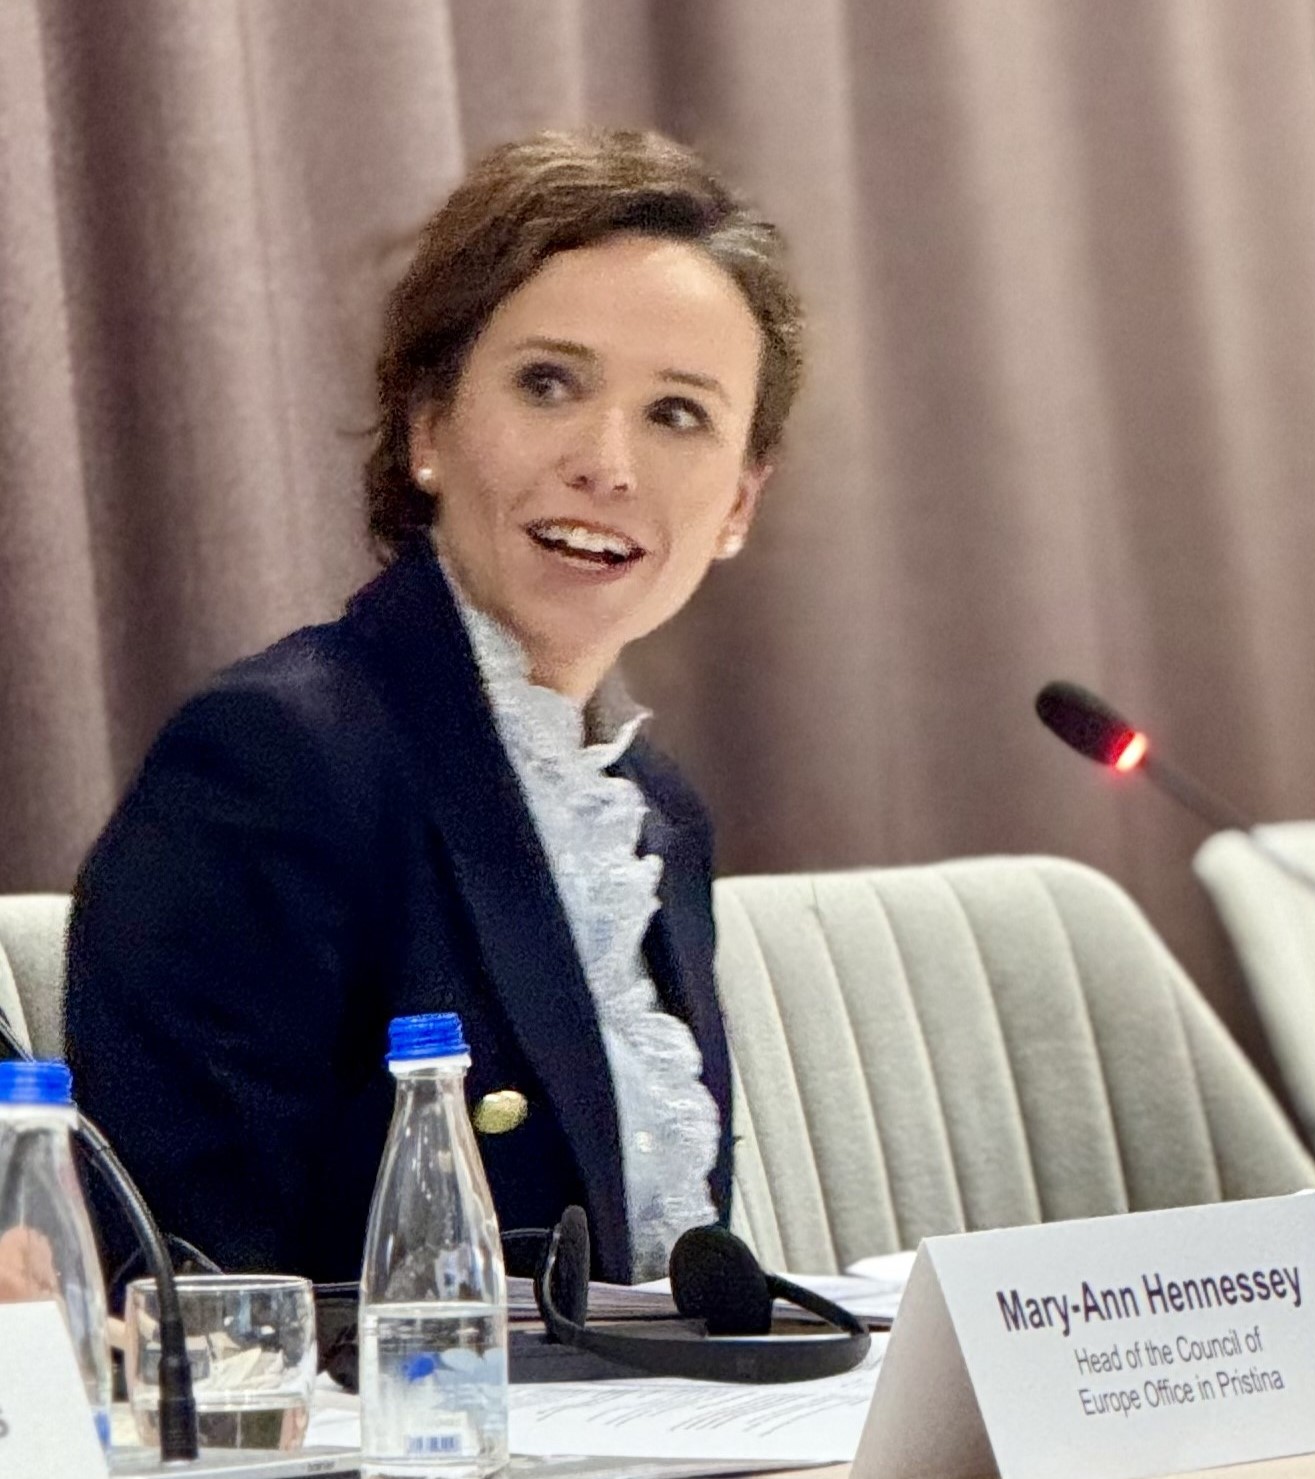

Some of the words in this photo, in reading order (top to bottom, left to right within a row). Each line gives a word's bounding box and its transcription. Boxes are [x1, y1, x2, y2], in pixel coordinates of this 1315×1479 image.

[996, 1281, 1140, 1337] Mary-Ann
[1142, 1265, 1302, 1316] Hennessey
[1074, 1342, 1123, 1375] Head
[1125, 1339, 1144, 1369] of
[1144, 1336, 1174, 1367] the
[1176, 1329, 1243, 1363] Council
[1244, 1327, 1265, 1355] of
[1078, 1383, 1142, 1417] Europe
[1143, 1379, 1195, 1409] Office
[1195, 1375, 1215, 1401] in
[1216, 1367, 1286, 1399] Pristina
